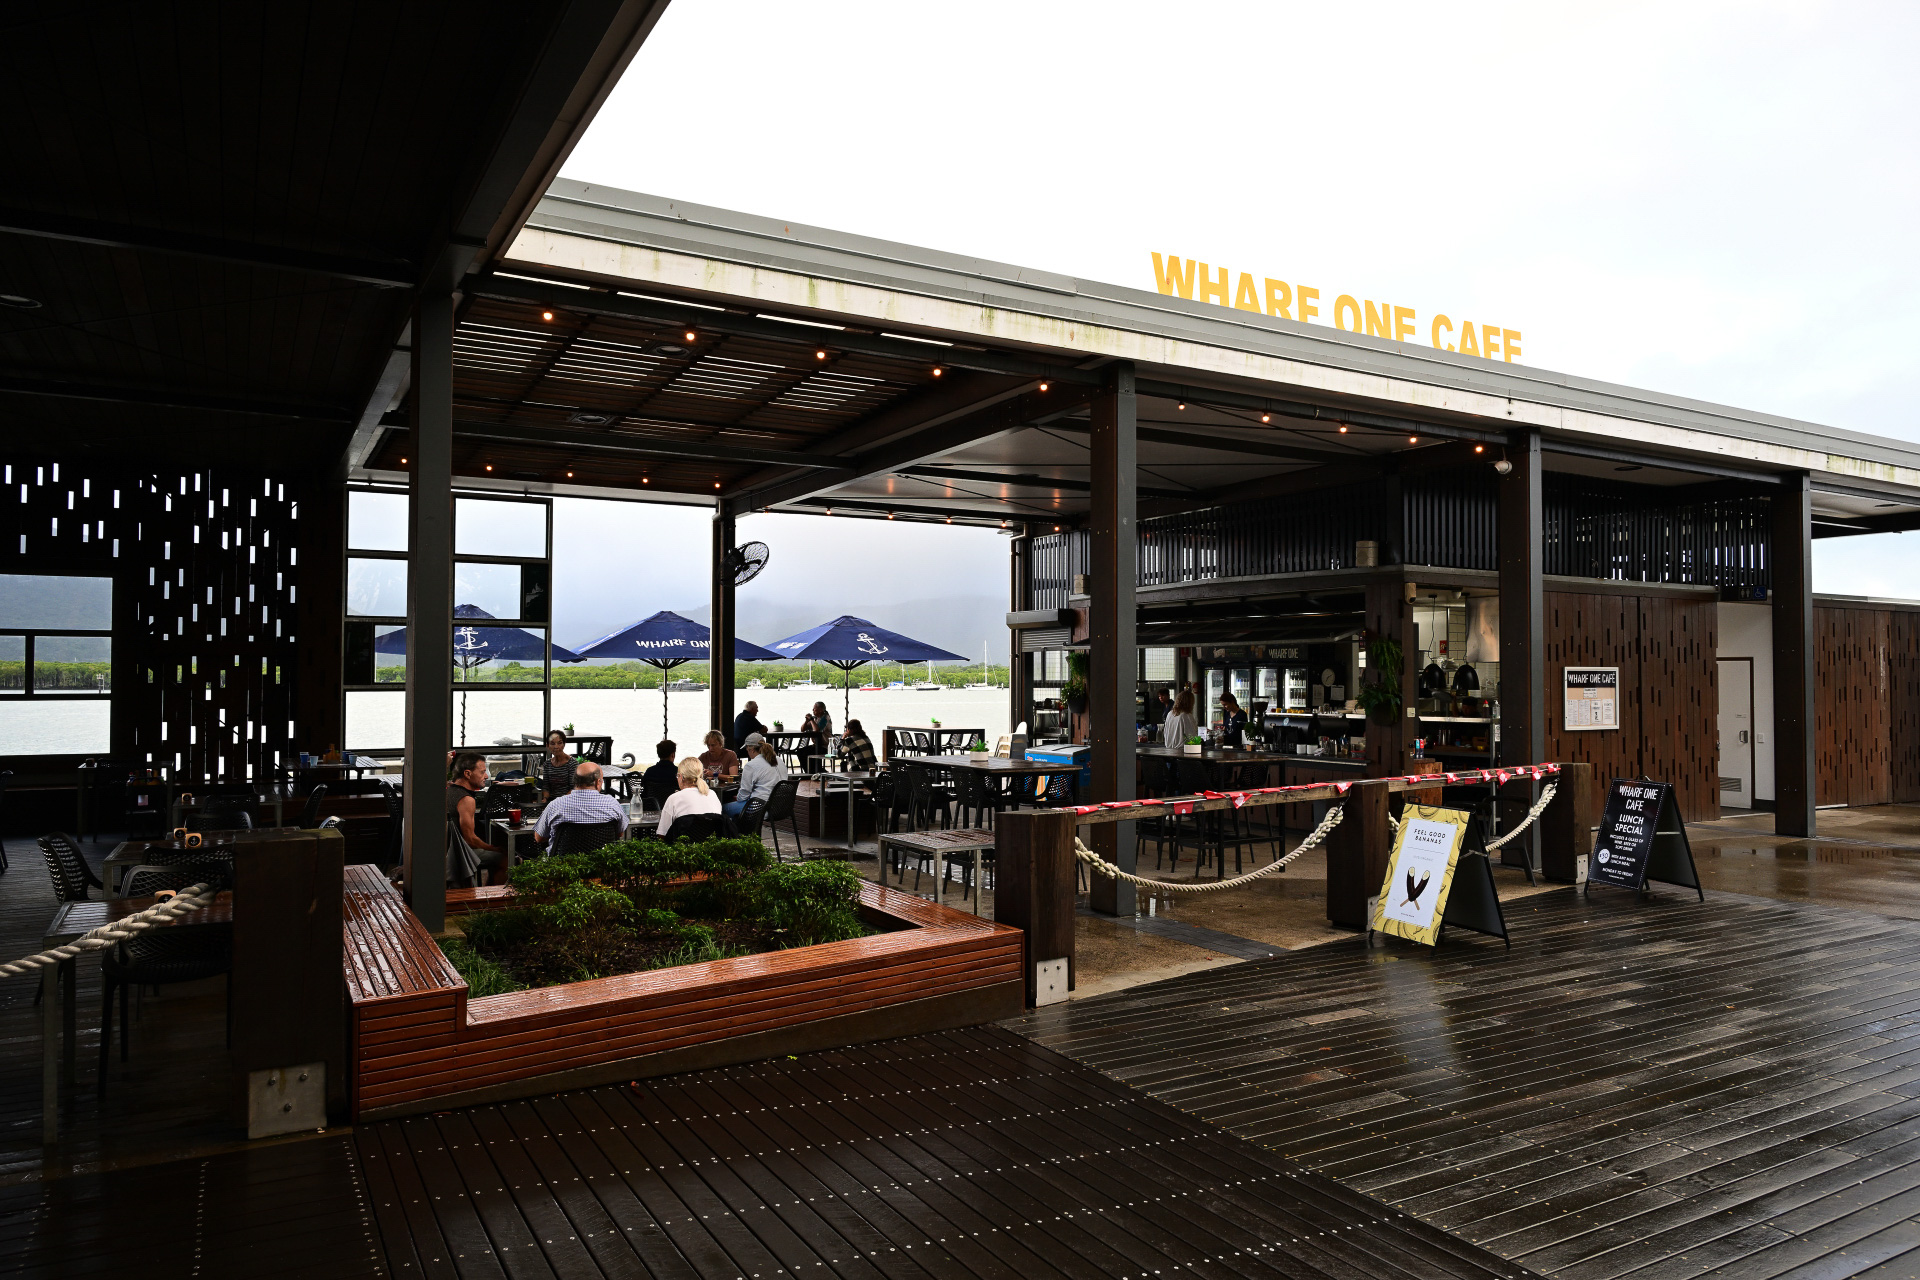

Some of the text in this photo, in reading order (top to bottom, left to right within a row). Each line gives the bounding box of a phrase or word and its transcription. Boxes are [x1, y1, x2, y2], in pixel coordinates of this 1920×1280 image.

[1151, 251, 1522, 365] WHARF ONE CAFE
[635, 638, 687, 649] WHARF
[1269, 648, 1298, 658] WHARF ONE
[1568, 674, 1588, 683] WHARF
[1590, 674, 1601, 683] ONE
[1619, 785, 1658, 799] WHARF ONE
[1626, 799, 1644, 811] CAFE
[1619, 814, 1644, 825] LUNCH
[1428, 831, 1446, 839] GOOD
[1615, 824, 1643, 835] SPECIAL
[1414, 835, 1442, 845] BANANAS
